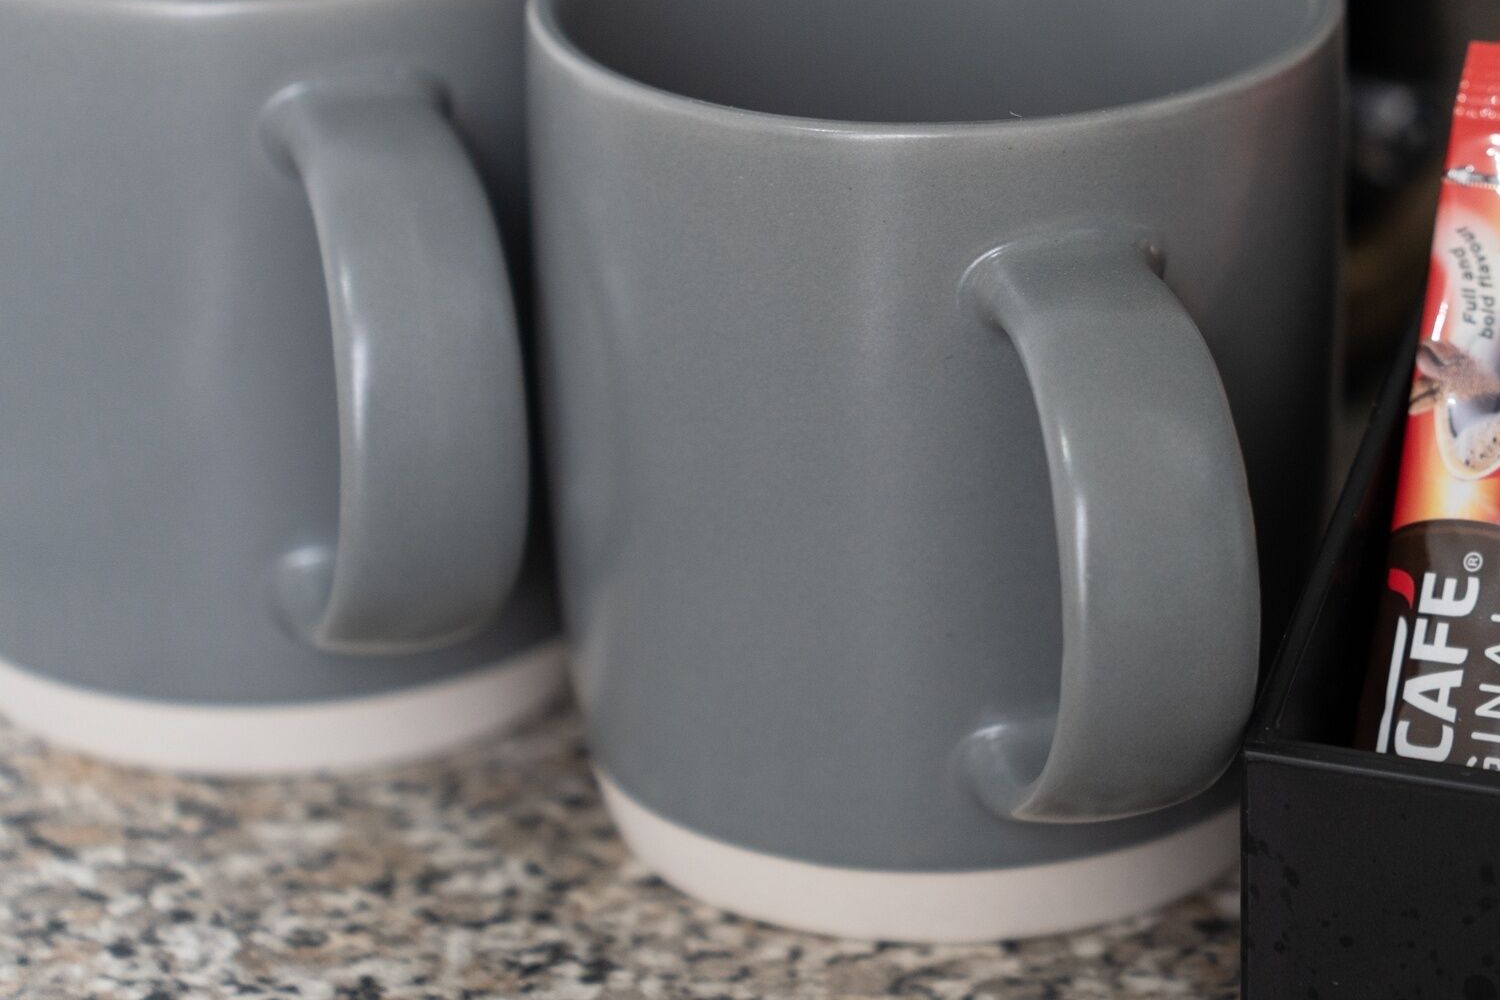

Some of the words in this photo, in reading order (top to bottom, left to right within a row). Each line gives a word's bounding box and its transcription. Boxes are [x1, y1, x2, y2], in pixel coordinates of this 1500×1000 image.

[1451, 248, 1473, 280] and
[1456, 227, 1492, 287] flavour
[1462, 288, 1477, 324] Full
[1479, 296, 1495, 339] bold
